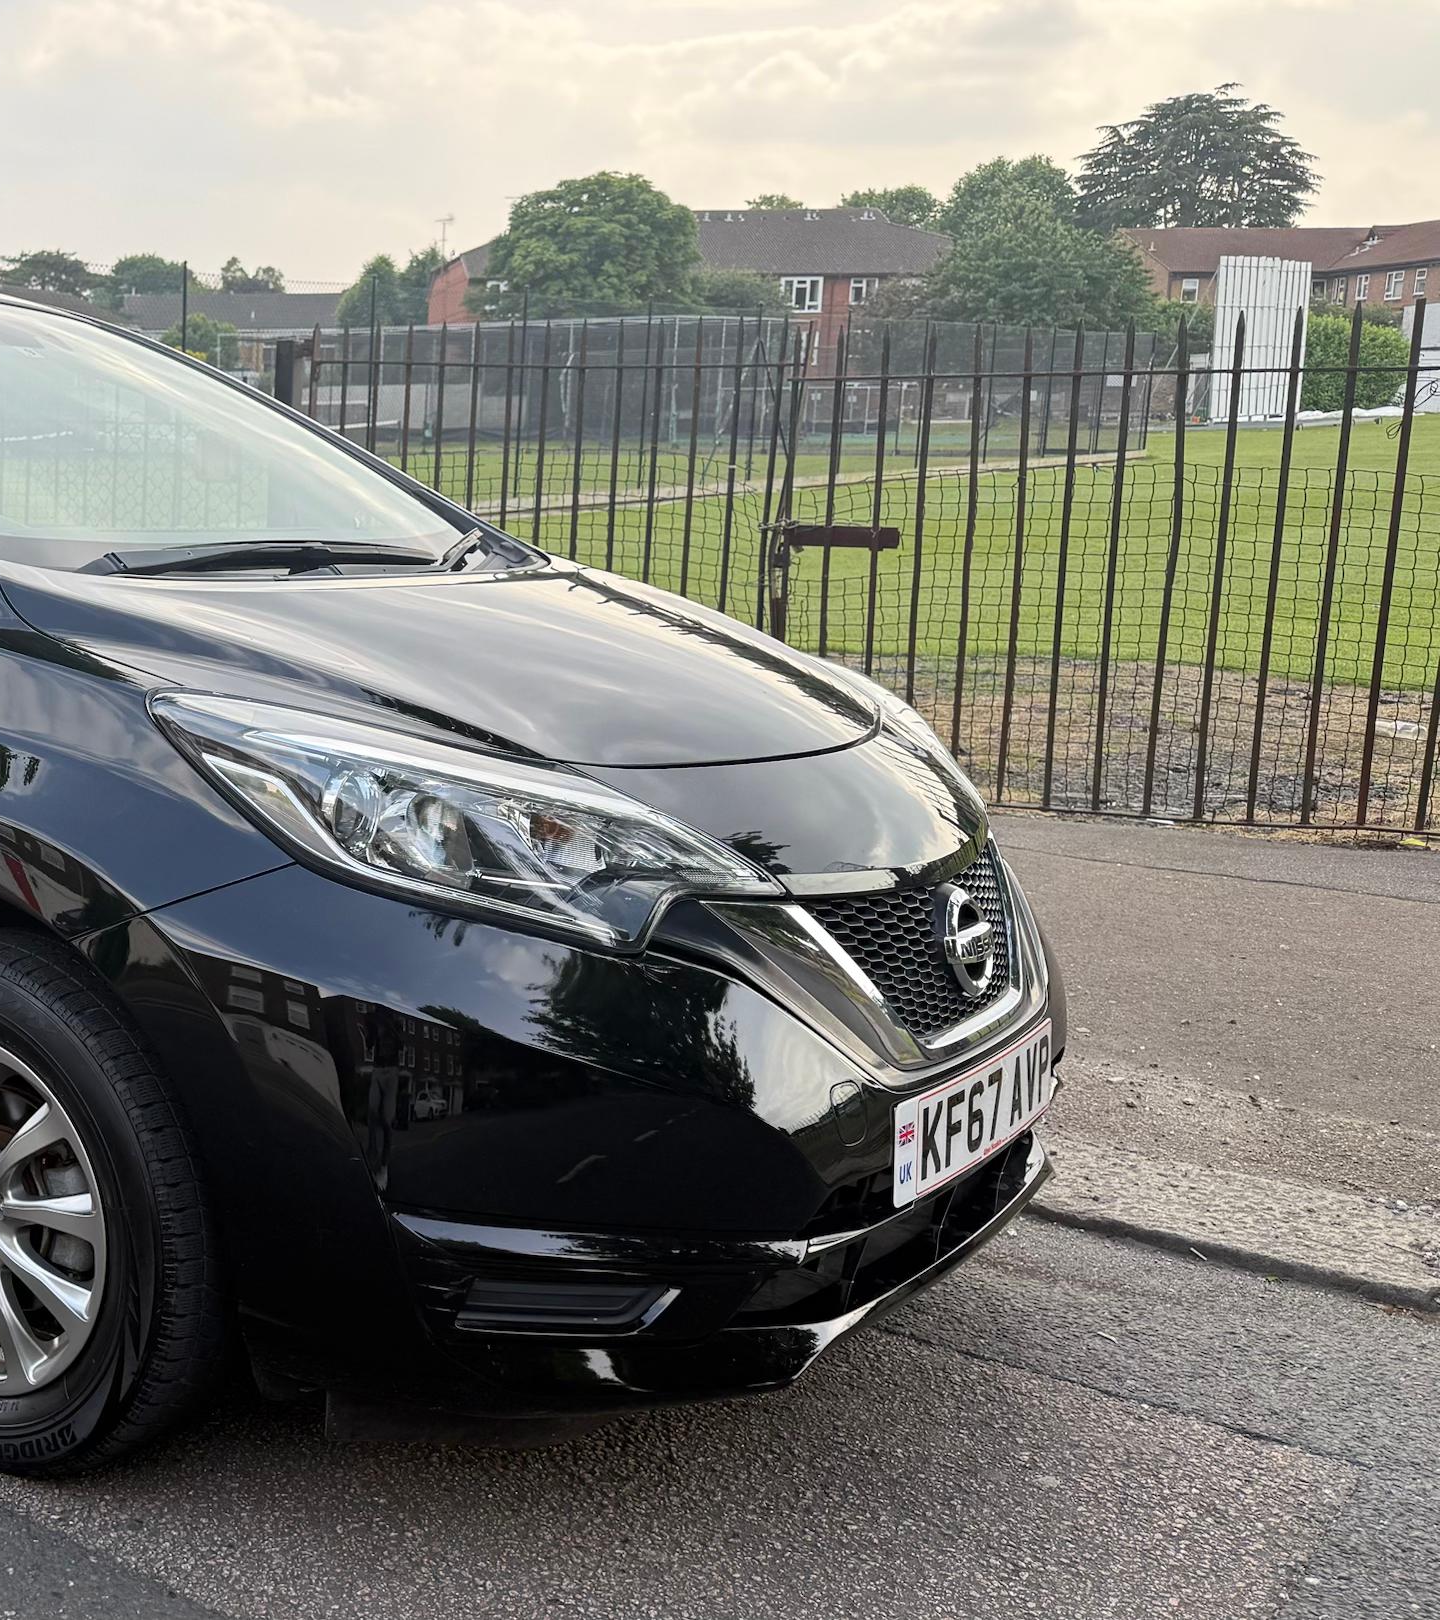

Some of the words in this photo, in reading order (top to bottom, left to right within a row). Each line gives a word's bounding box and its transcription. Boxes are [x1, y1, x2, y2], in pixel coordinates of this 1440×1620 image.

[961, 937, 993, 958] NISS
[921, 1068, 1003, 1180] KF67
[1009, 1034, 1049, 1126] AVP
[898, 1161, 913, 1185] UK
